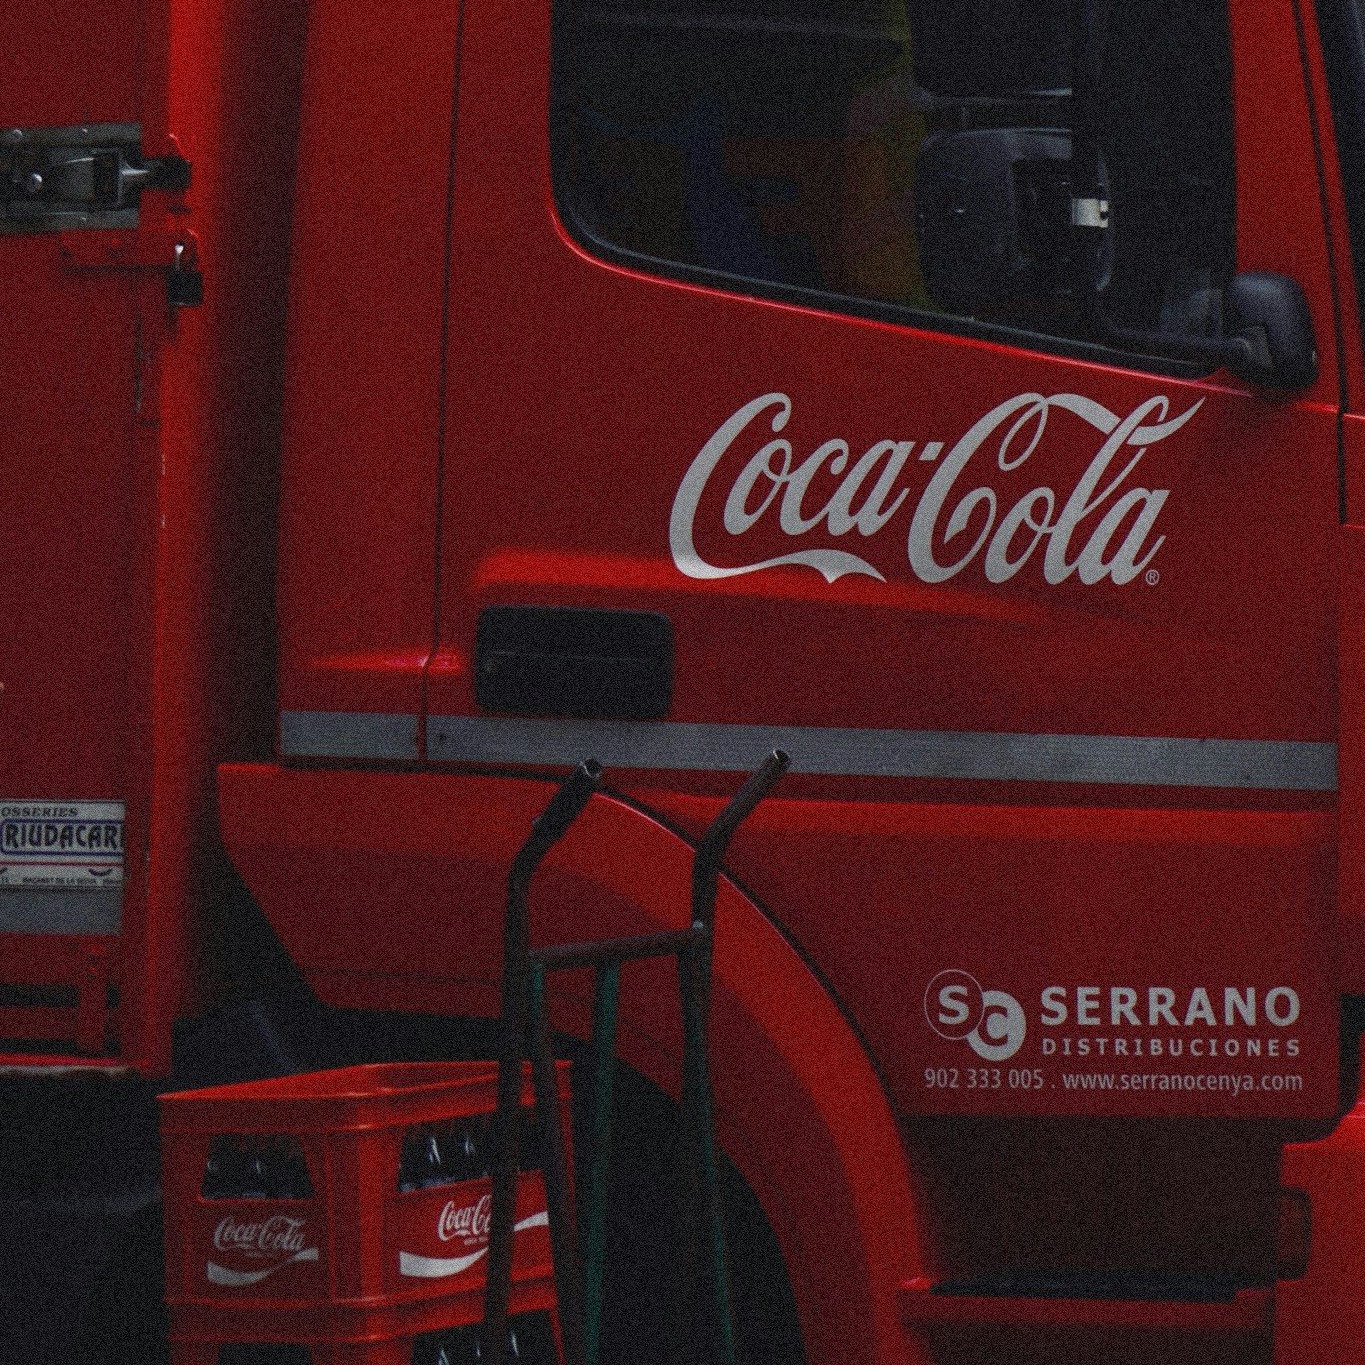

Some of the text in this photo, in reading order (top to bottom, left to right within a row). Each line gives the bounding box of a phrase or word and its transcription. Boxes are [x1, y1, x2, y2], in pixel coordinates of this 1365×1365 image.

[669, 391, 1206, 586] Coca-Cola
[5, 823, 124, 850] RIUDACAR
[1040, 986, 1301, 1027] SERRANO
[1042, 1038, 1301, 1057] DISTRIBUCIONES
[924, 1069, 1303, 1098] 902 333 005 www.serranocenya.com
[214, 1215, 307, 1253] Coca-Cola
